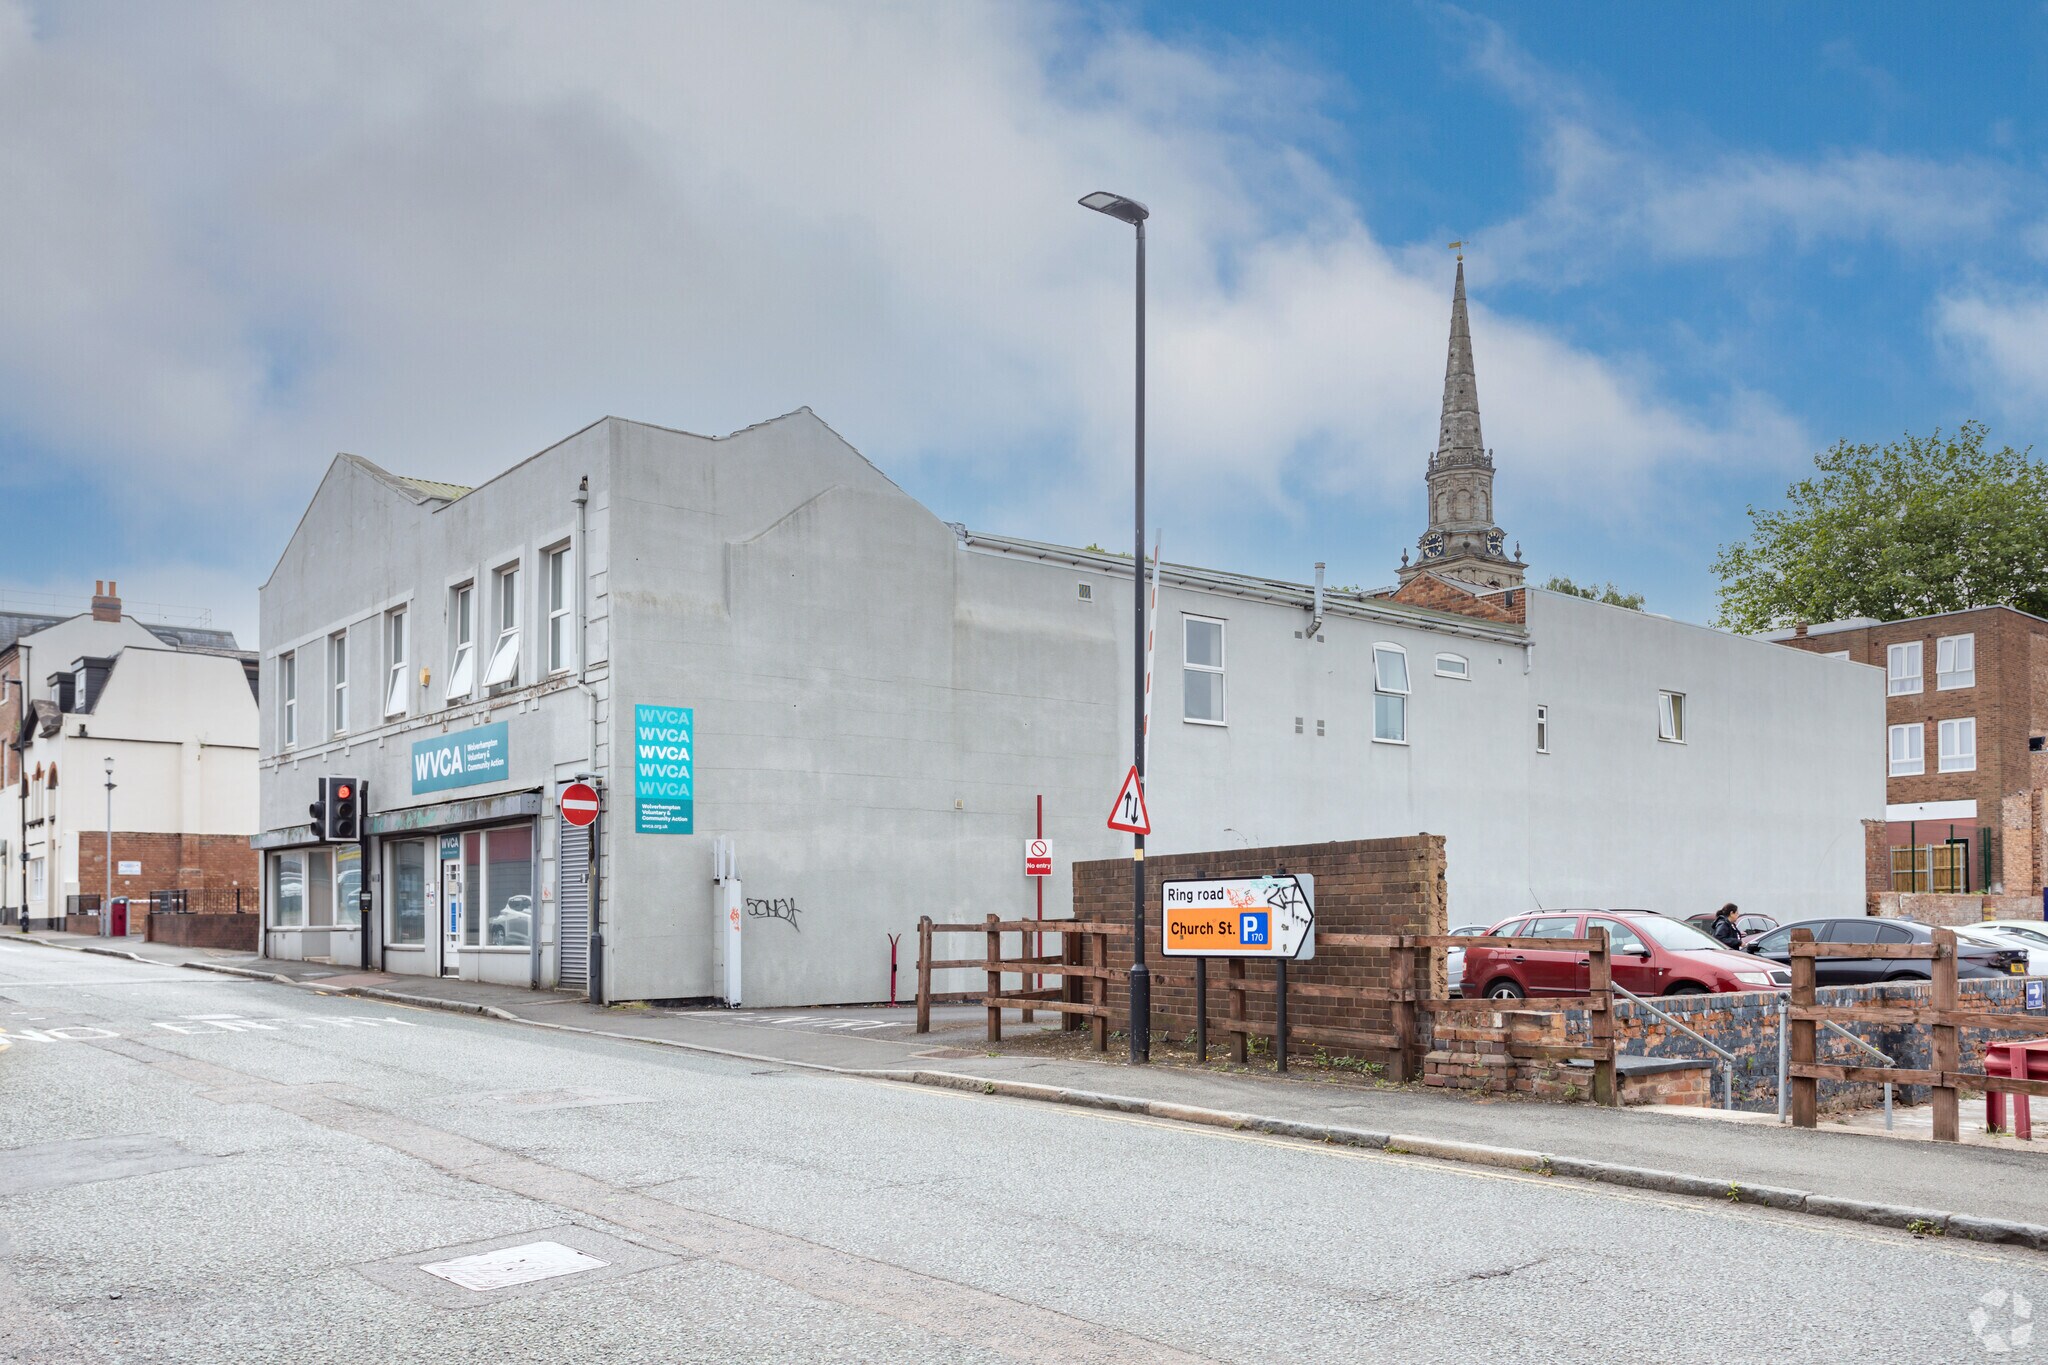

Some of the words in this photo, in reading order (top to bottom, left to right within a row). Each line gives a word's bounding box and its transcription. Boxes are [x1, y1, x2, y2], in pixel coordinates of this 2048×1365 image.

[639, 709, 690, 725] WVCA
[639, 727, 690, 743] WVCA
[467, 739, 498, 752] Wolverhampton
[639, 745, 690, 761] WVCA
[415, 745, 463, 781] WVCA
[467, 752, 486, 762] Voluntary
[467, 760, 490, 772] Community
[490, 758, 504, 767] Action
[639, 763, 690, 779] WVCA
[639, 781, 690, 797] WVCA
[641, 809, 666, 817] Voluntary
[641, 815, 671, 823] Community
[441, 837, 459, 849] WVCA
[1168, 888, 1193, 903] Ring
[1197, 887, 1224, 900] road
[1171, 922, 1214, 935] Church
[1218, 921, 1236, 935] St.
[1243, 916, 1258, 942] P
[1251, 933, 1264, 942] 170
